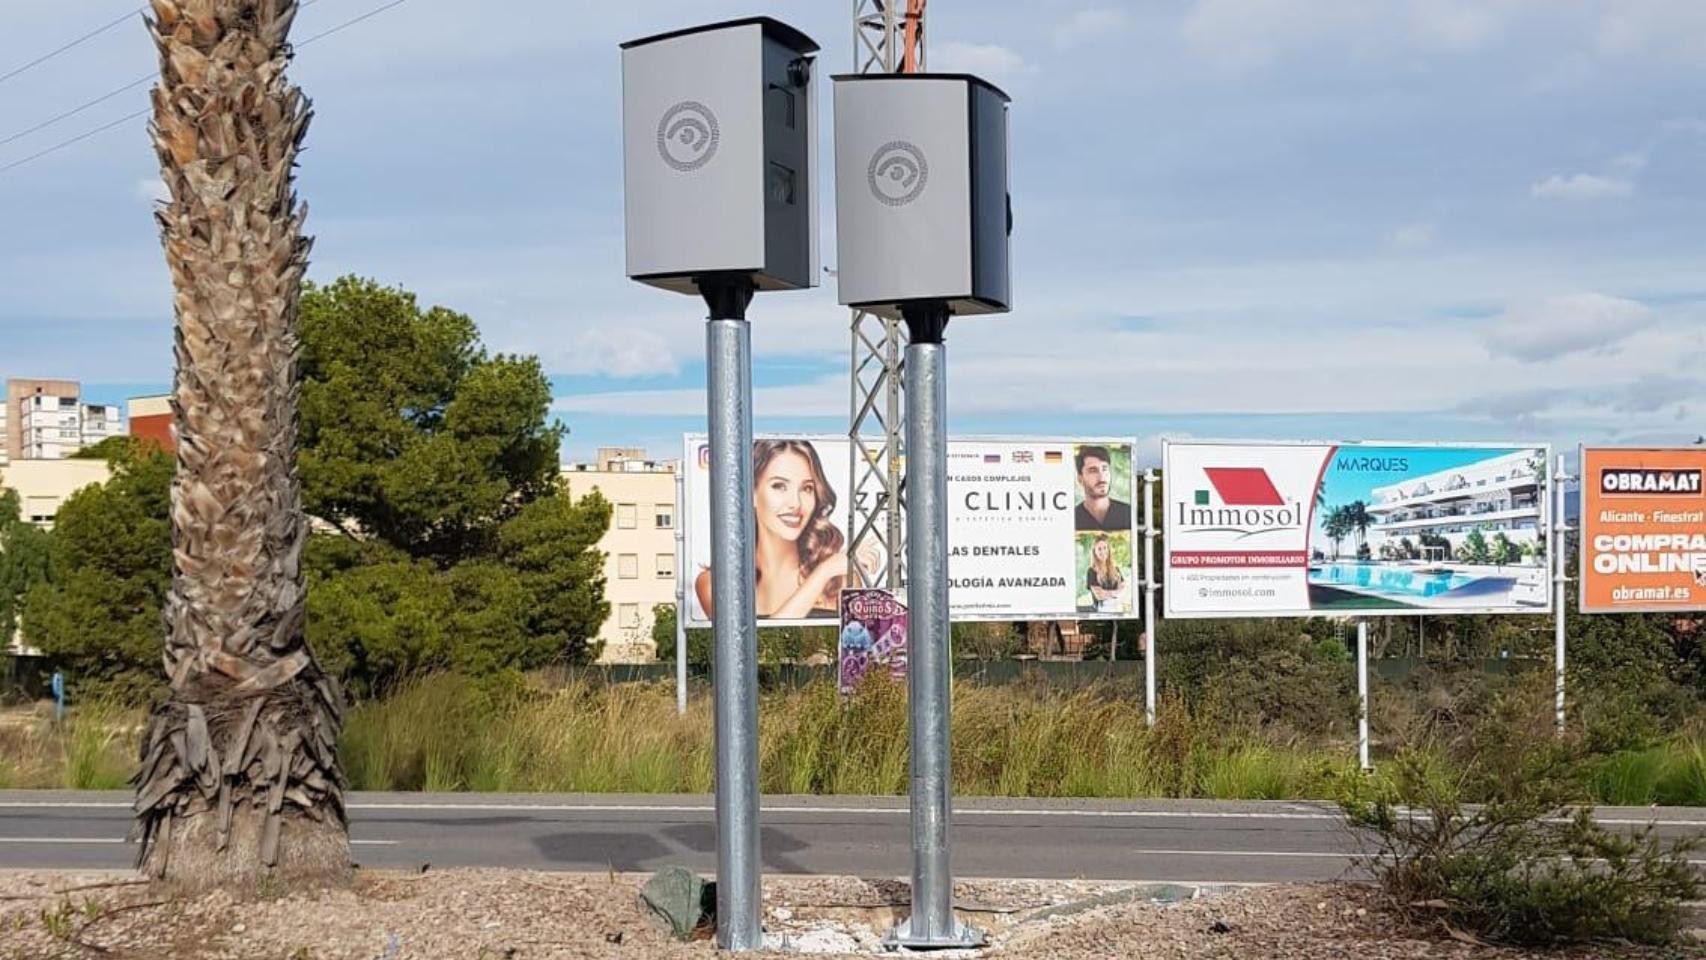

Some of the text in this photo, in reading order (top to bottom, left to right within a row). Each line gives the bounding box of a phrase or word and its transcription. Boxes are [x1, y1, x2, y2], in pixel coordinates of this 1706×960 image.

[1336, 457, 1408, 472] MARQUES
[1603, 473, 1700, 491] OBRAMAT
[965, 491, 1067, 511] CLINIC
[1178, 501, 1302, 526] Immosol
[1600, 510, 1645, 523] Alicante
[1594, 534, 1706, 551] COMPRA
[972, 545, 1040, 556] DENTALES
[1171, 555, 1200, 565] GRUPO
[1201, 555, 1246, 565] PROMOTOR
[1594, 552, 1706, 574] ONLINE
[997, 576, 1066, 587] AVANZADA
[1209, 587, 1275, 597] immosol.com
[1613, 584, 1690, 600] obramat.es
